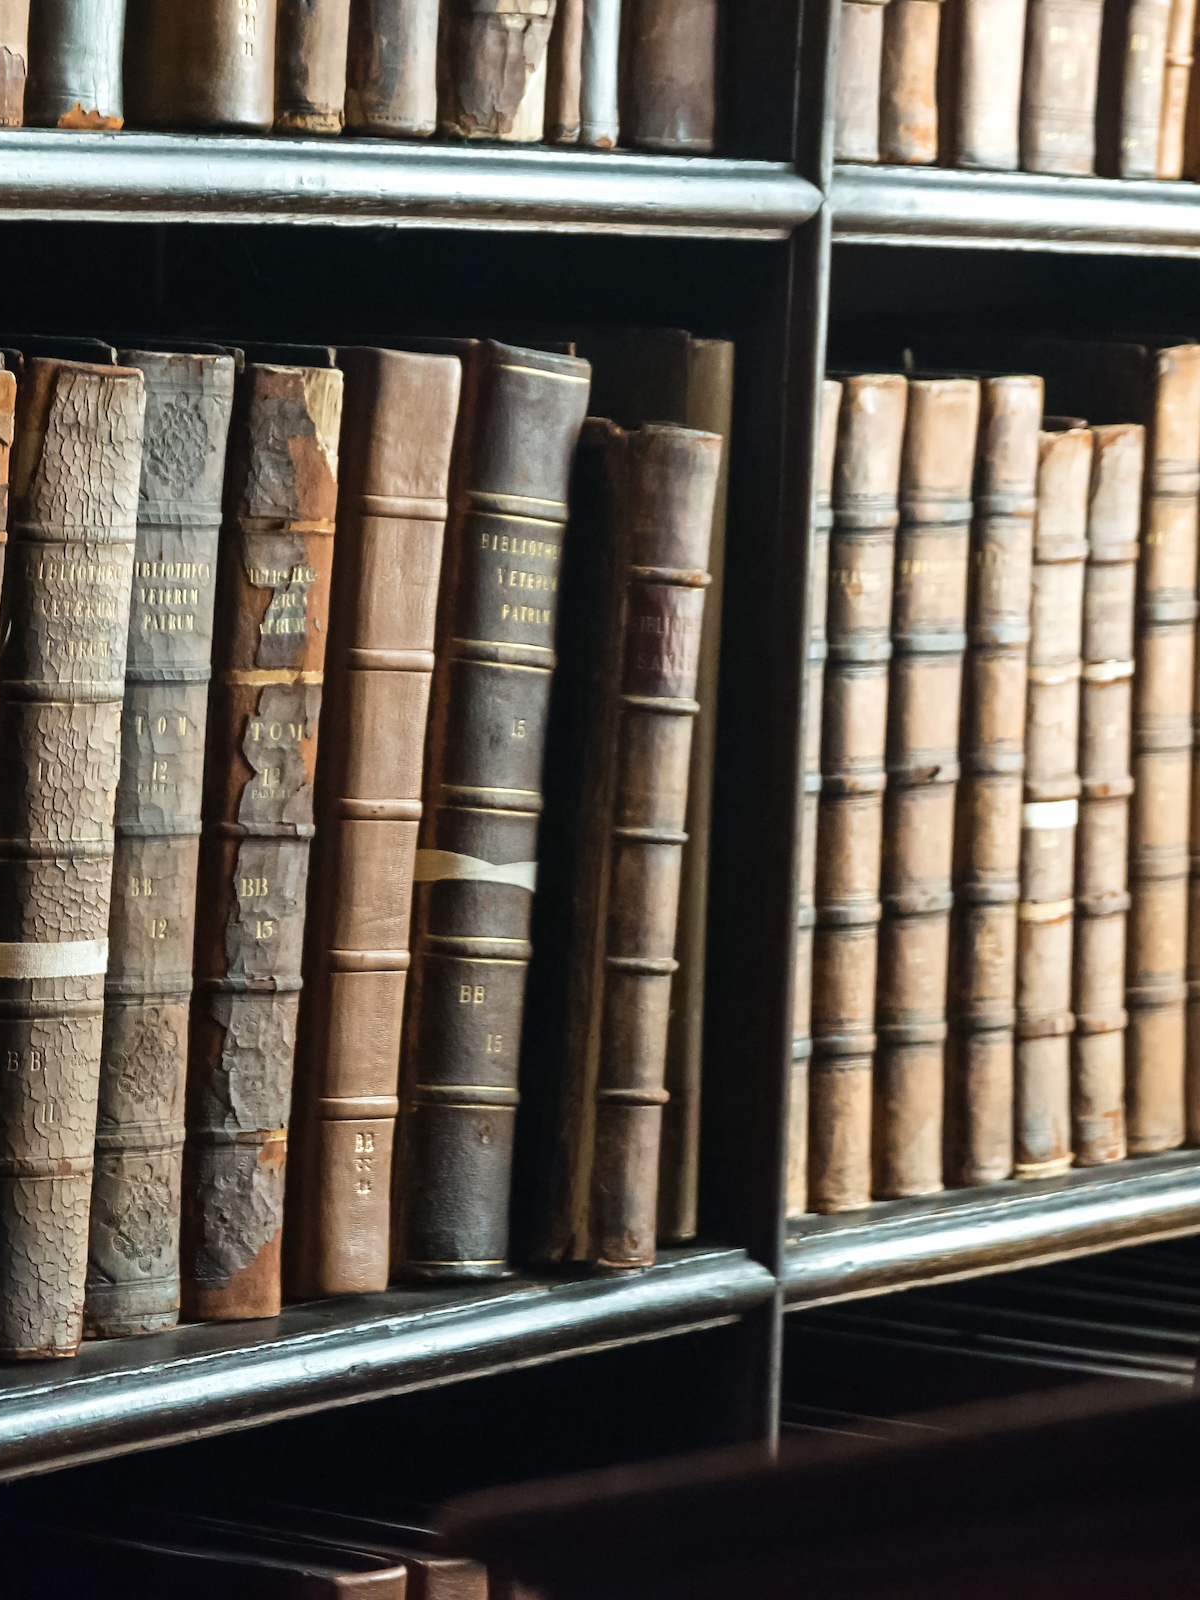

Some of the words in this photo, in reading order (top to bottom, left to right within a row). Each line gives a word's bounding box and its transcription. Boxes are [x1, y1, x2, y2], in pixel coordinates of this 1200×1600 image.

[134, 561, 212, 579] IBLIOTHECA
[141, 588, 199, 605] VETERUM
[143, 613, 195, 631] PATRUM
[502, 602, 551, 624] PATRUM
[135, 715, 187, 736] TOM
[250, 722, 303, 742] TOM
[241, 877, 269, 897] BB
[459, 984, 485, 1004] BB
[354, 1132, 374, 1152] BB
